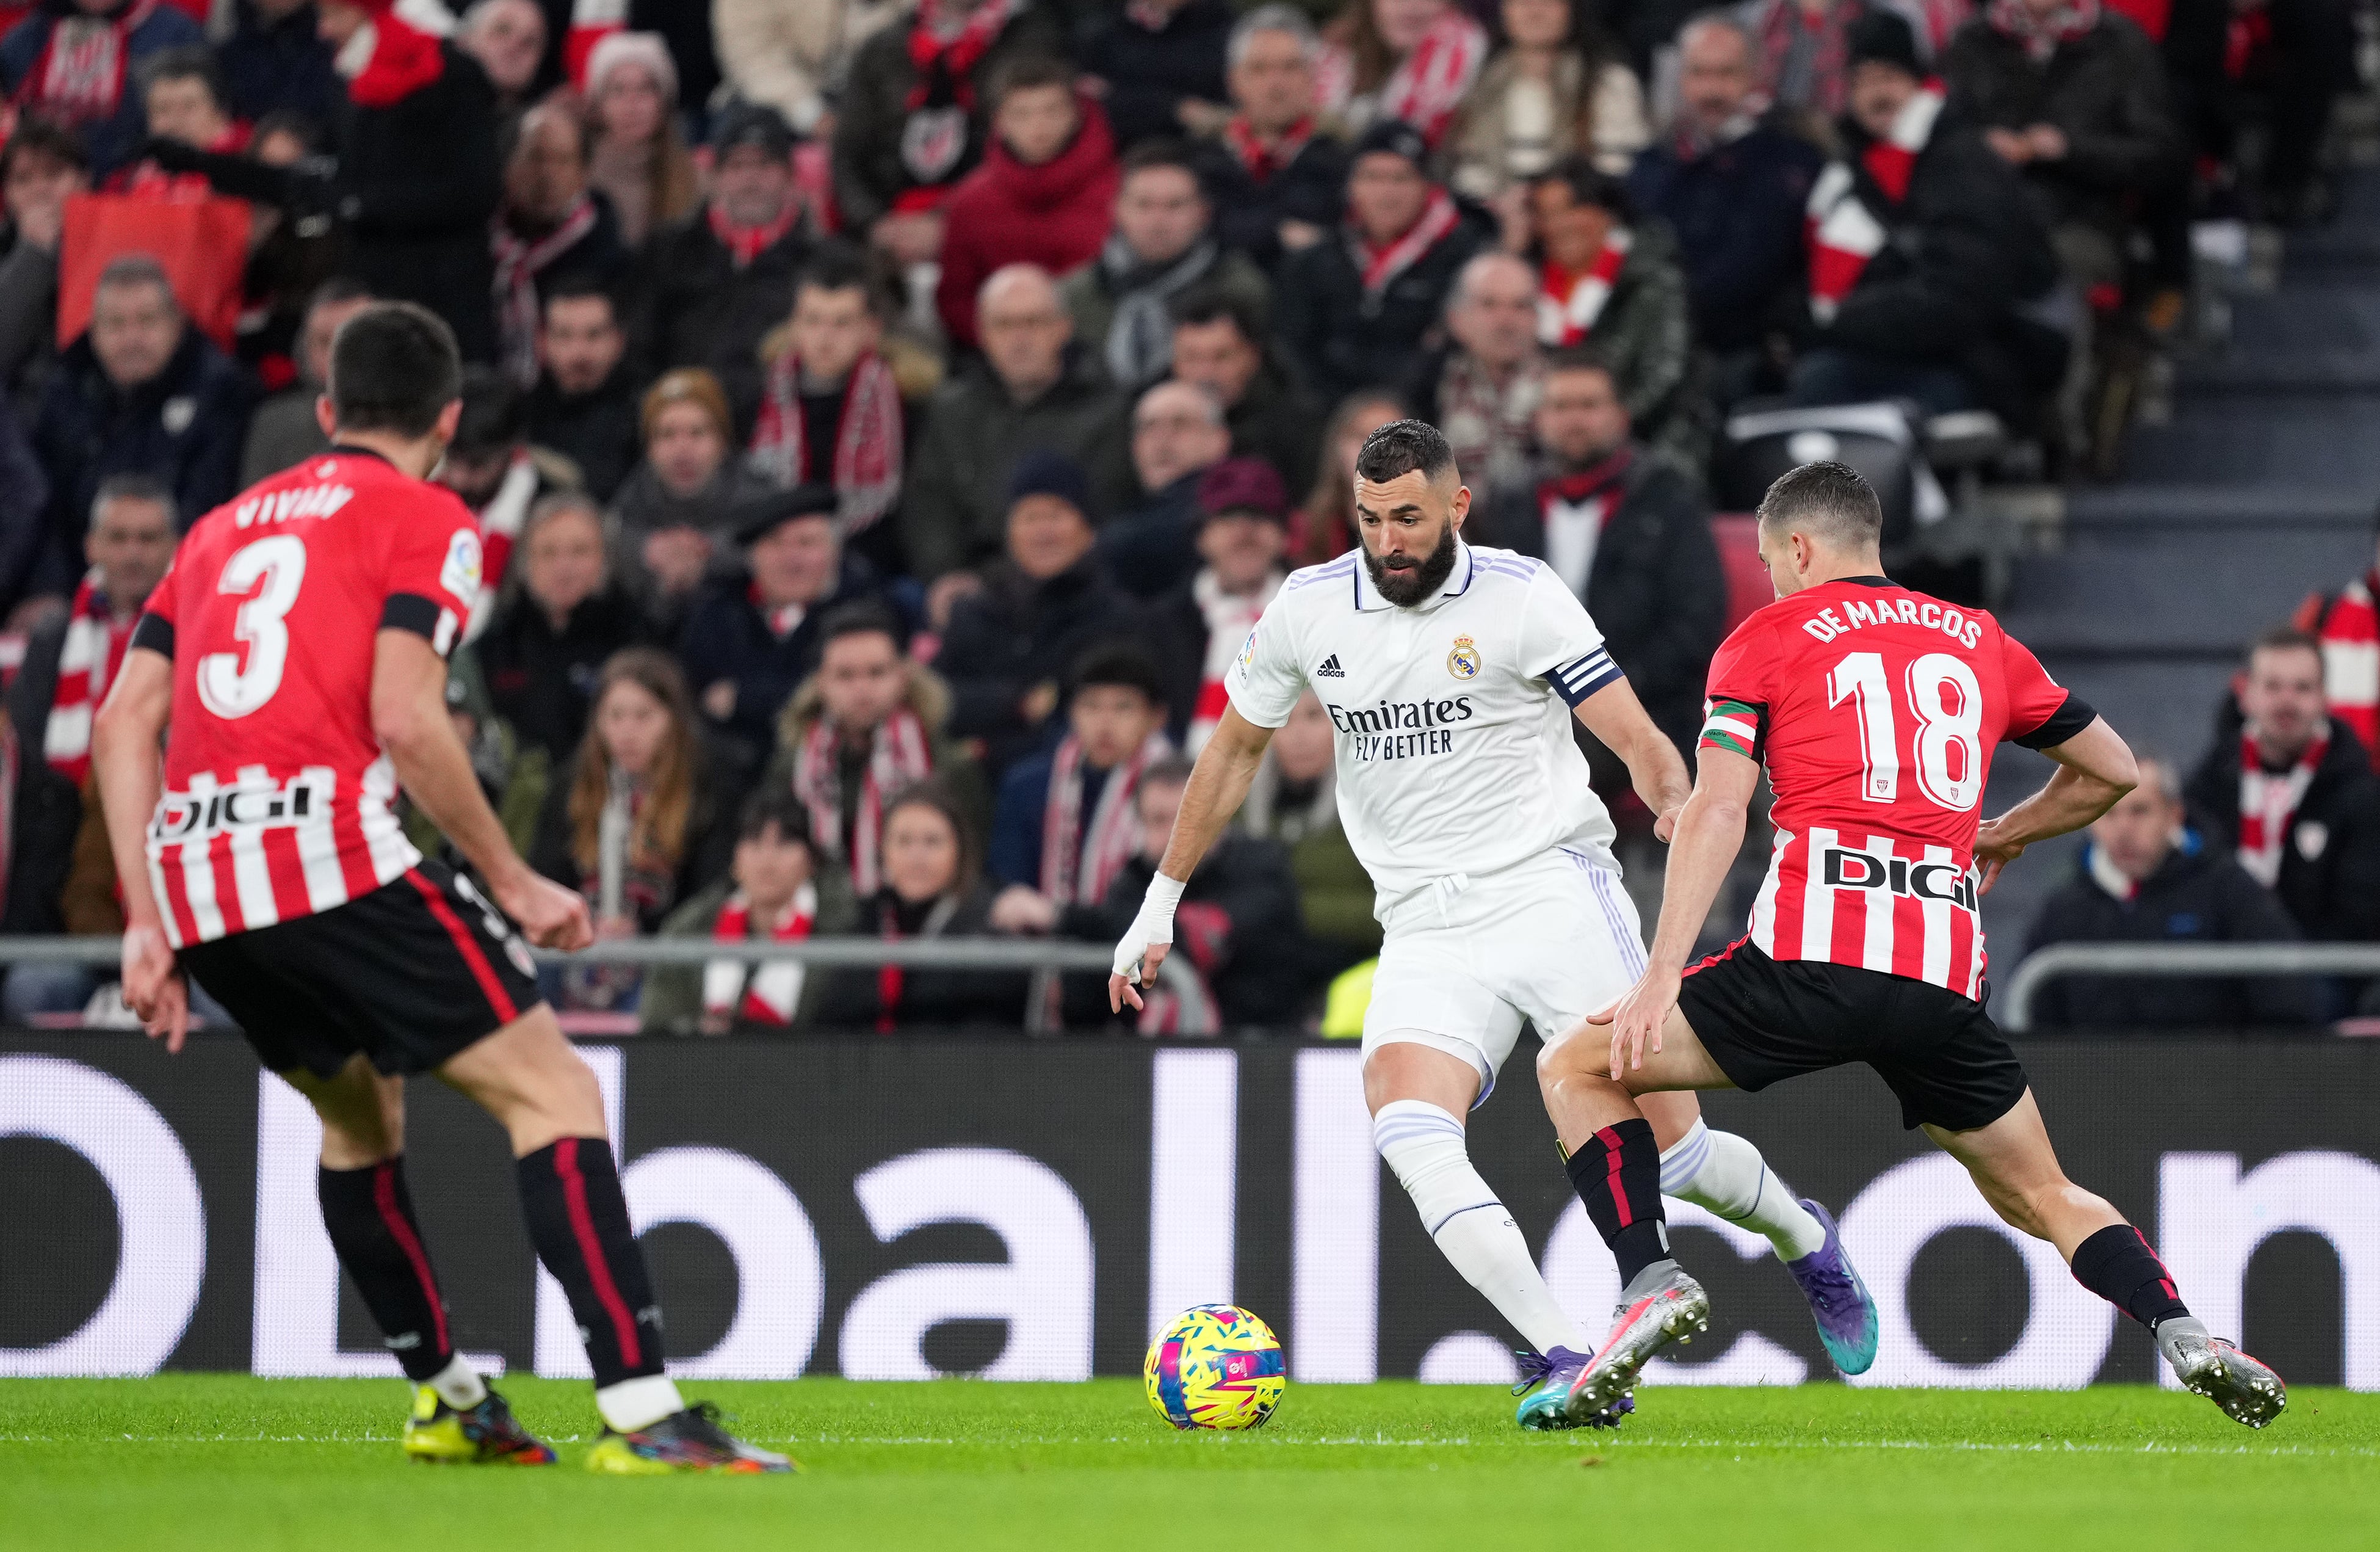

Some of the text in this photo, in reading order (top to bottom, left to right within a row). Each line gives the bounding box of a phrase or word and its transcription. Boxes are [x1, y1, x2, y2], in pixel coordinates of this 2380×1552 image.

[236, 483, 355, 529] VIVIAN
[196, 534, 307, 720] 3
[1802, 599, 1982, 650] DE MARCOS
[1317, 668, 1345, 678] adidas
[1327, 697, 1473, 733] Emirates
[1826, 651, 1983, 812] 18
[1356, 729, 1452, 762] FLY BETTER
[155, 786, 310, 837] DIGI
[1825, 849, 1977, 912] DIGI
